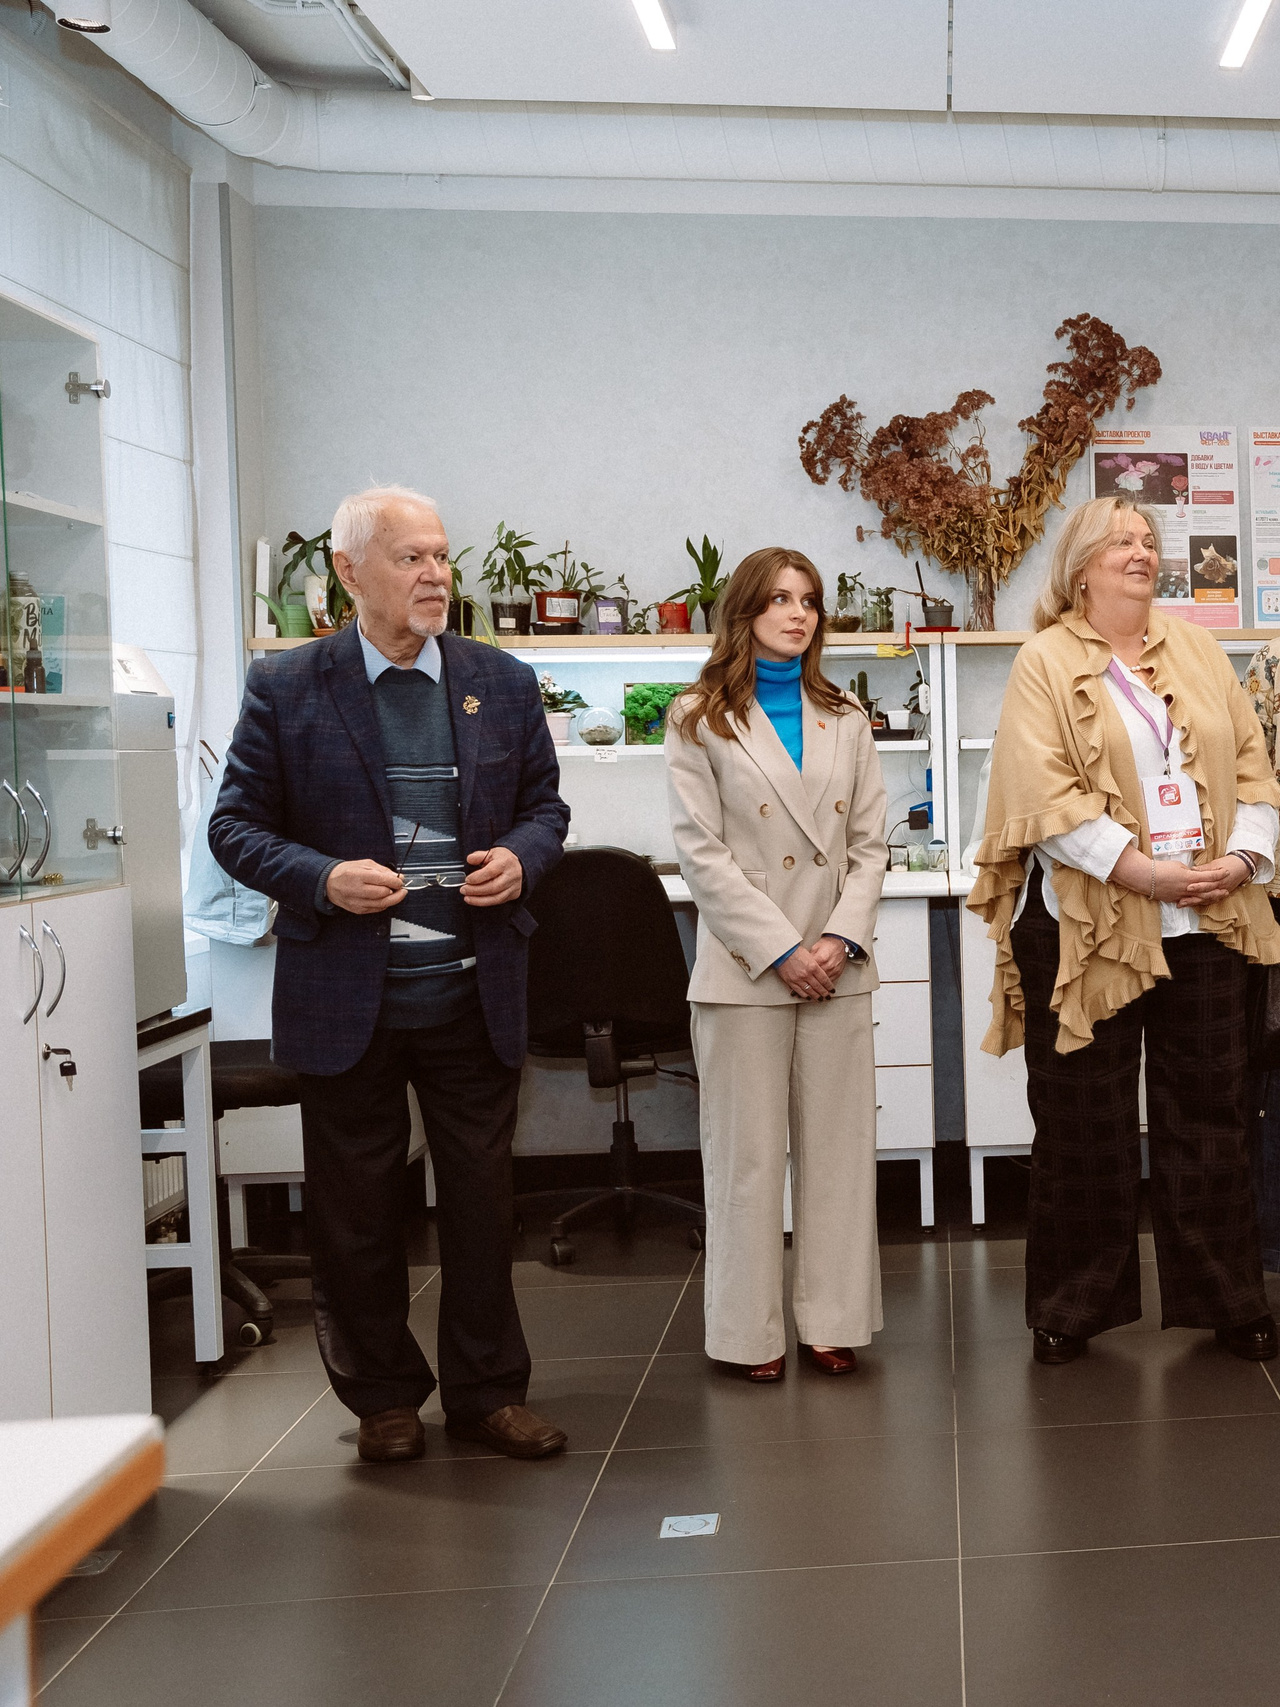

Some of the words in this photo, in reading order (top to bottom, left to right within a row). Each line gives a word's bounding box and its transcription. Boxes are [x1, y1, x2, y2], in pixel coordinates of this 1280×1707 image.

[1095, 430, 1123, 438] ВЫСТАВКА
[1123, 430, 1151, 438] ПРОЕКТОВ
[1199, 431, 1232, 441] КВАНТ
[1190, 454, 1214, 462] ДОБАВКИ
[1153, 830, 1199, 840] ОРГАНАТОР
